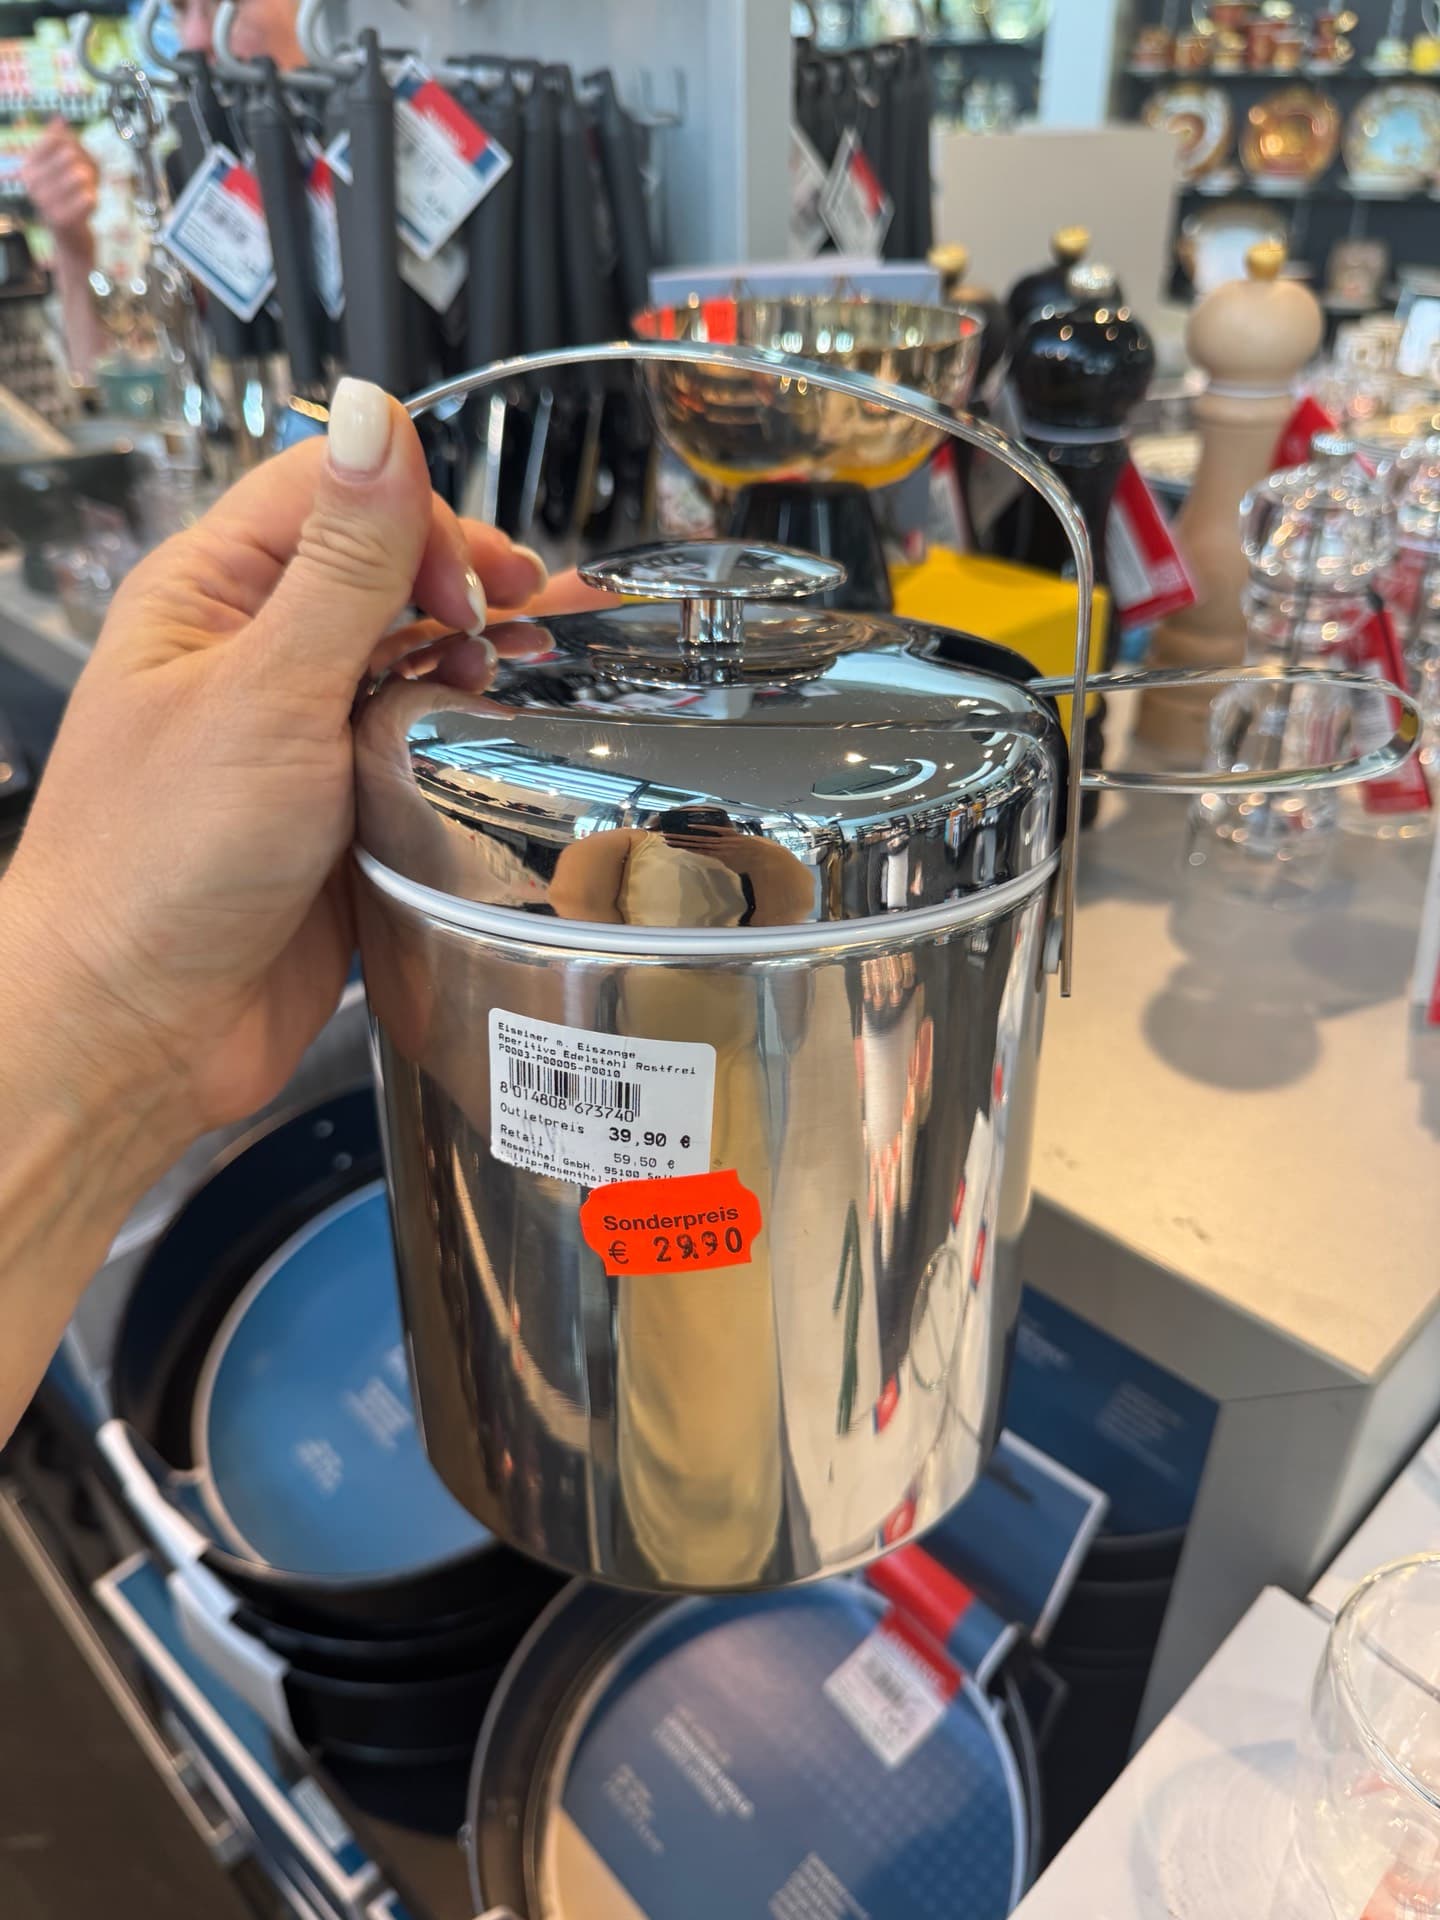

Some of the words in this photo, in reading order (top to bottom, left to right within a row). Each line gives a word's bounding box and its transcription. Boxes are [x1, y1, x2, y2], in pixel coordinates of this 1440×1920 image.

[498, 1022, 549, 1042] Eiseimer
[577, 1042, 636, 1059] Eiszange
[498, 1033, 556, 1055] Aperitivo
[563, 1050, 626, 1069] Edelstahl
[635, 1062, 696, 1075] Rostfrei
[500, 1102, 584, 1134] Outletpreis
[609, 1127, 667, 1147] 39,90
[680, 1135, 691, 1149] €
[500, 1124, 543, 1146] Retail
[501, 1138, 555, 1162] Rosenthal
[604, 1166, 640, 1179] 95100
[603, 1207, 739, 1231] Sonderpreis
[608, 1240, 629, 1265] €
